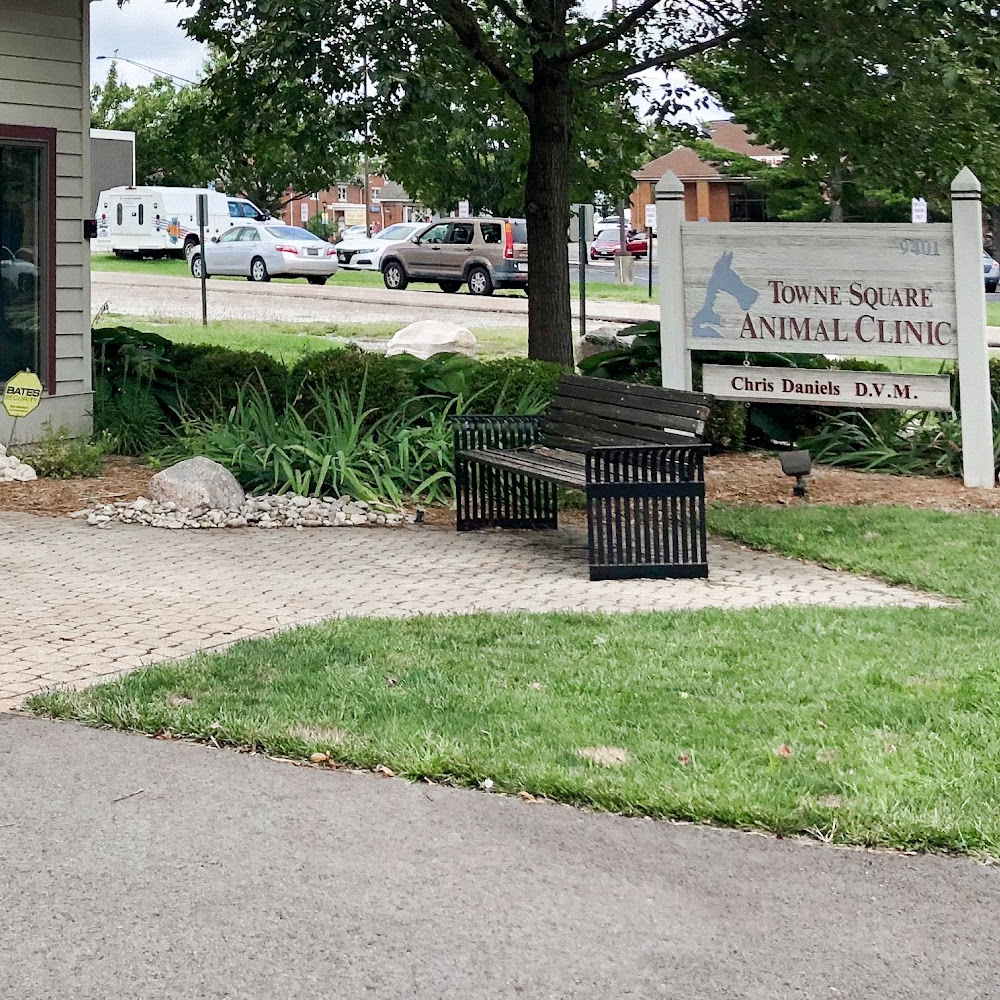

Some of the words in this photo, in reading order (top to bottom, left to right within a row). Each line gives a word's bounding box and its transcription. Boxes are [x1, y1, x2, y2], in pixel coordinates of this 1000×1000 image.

[899, 239, 940, 256] 9401
[768, 280, 841, 305] TOWNE
[849, 282, 933, 310] SQUARE
[740, 312, 848, 341] ANIMAL
[855, 315, 951, 345] CLINIC
[7, 386, 40, 397] BATES
[731, 376, 774, 393] Chris
[782, 379, 840, 396] Daniels
[855, 382, 918, 400] D.V.M.
